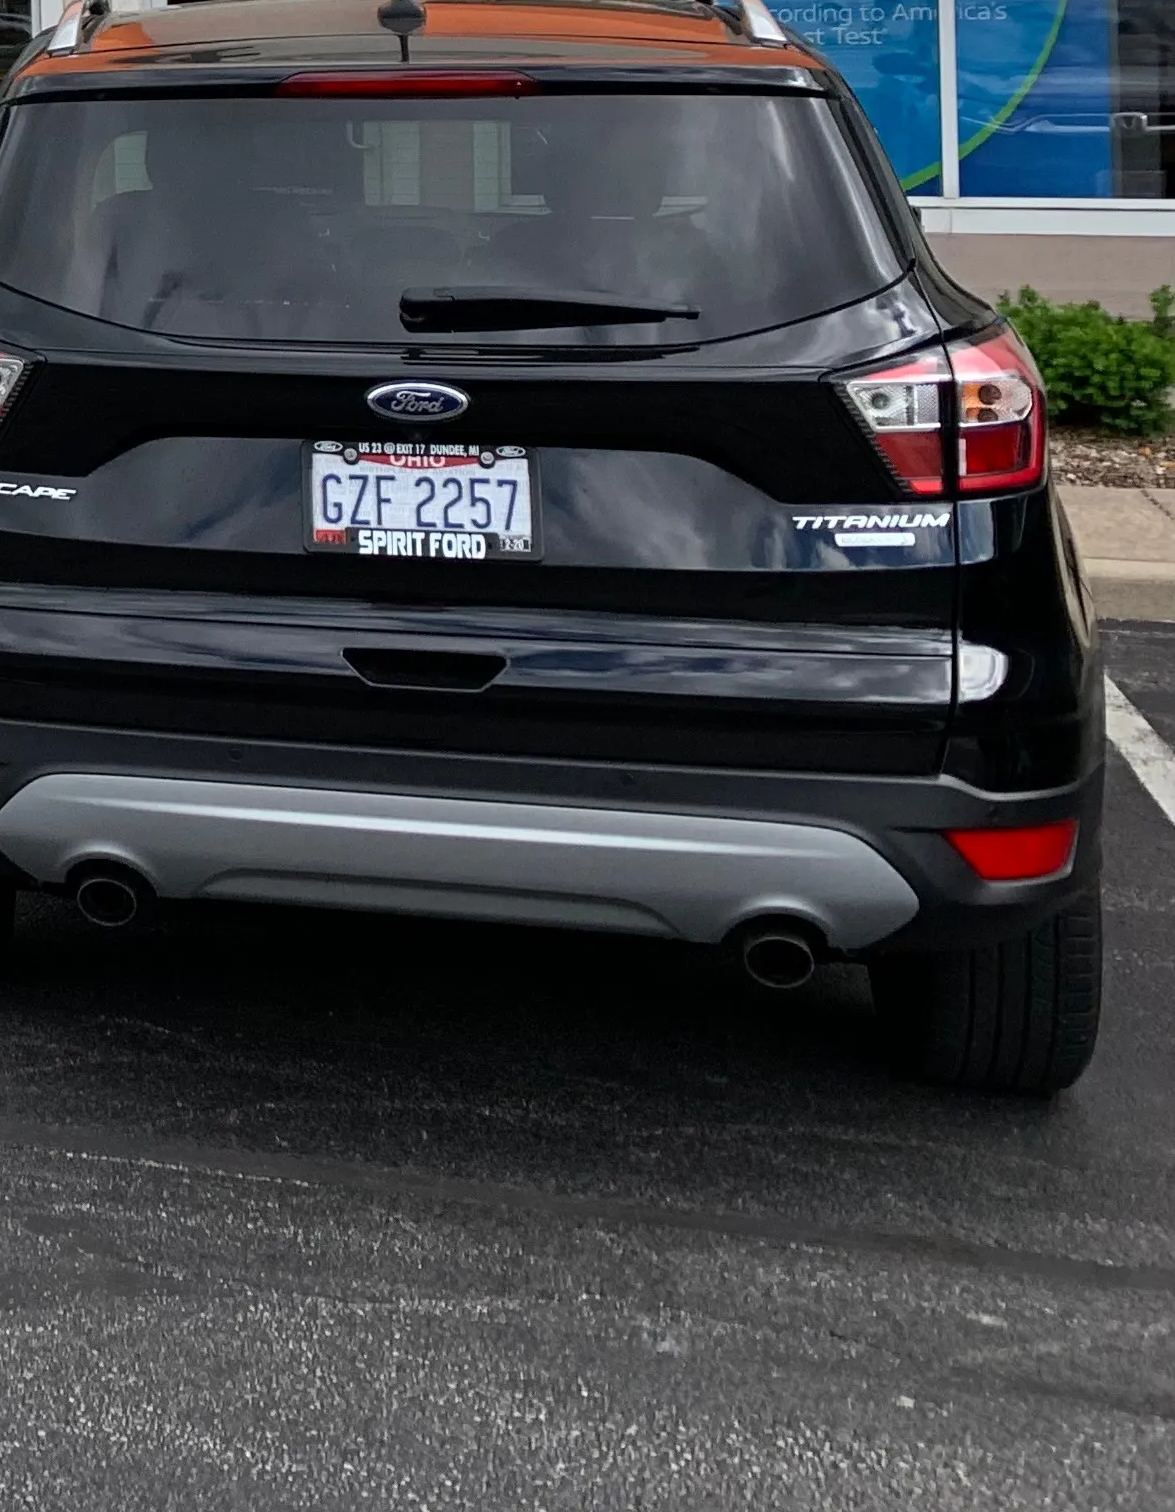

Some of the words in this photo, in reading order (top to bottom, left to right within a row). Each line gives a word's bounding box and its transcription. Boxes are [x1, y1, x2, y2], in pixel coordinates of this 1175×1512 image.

[769, 4, 852, 26] ording
[860, 7, 885, 21] to
[892, 2, 1007, 21] Amica's
[391, 390, 443, 413] Ford
[358, 442, 370, 453] US
[372, 443, 382, 454] 23
[385, 442, 395, 454] @
[396, 443, 413, 454] EXIT
[416, 444, 425, 454] 17
[430, 444, 467, 457] DUNDEE,
[469, 445, 479, 456] MI
[322, 474, 396, 526] GZF
[415, 477, 518, 531] 2257
[792, 513, 950, 529] TITANIUM
[358, 530, 425, 556] SPIRIT
[429, 533, 486, 559] FORD
